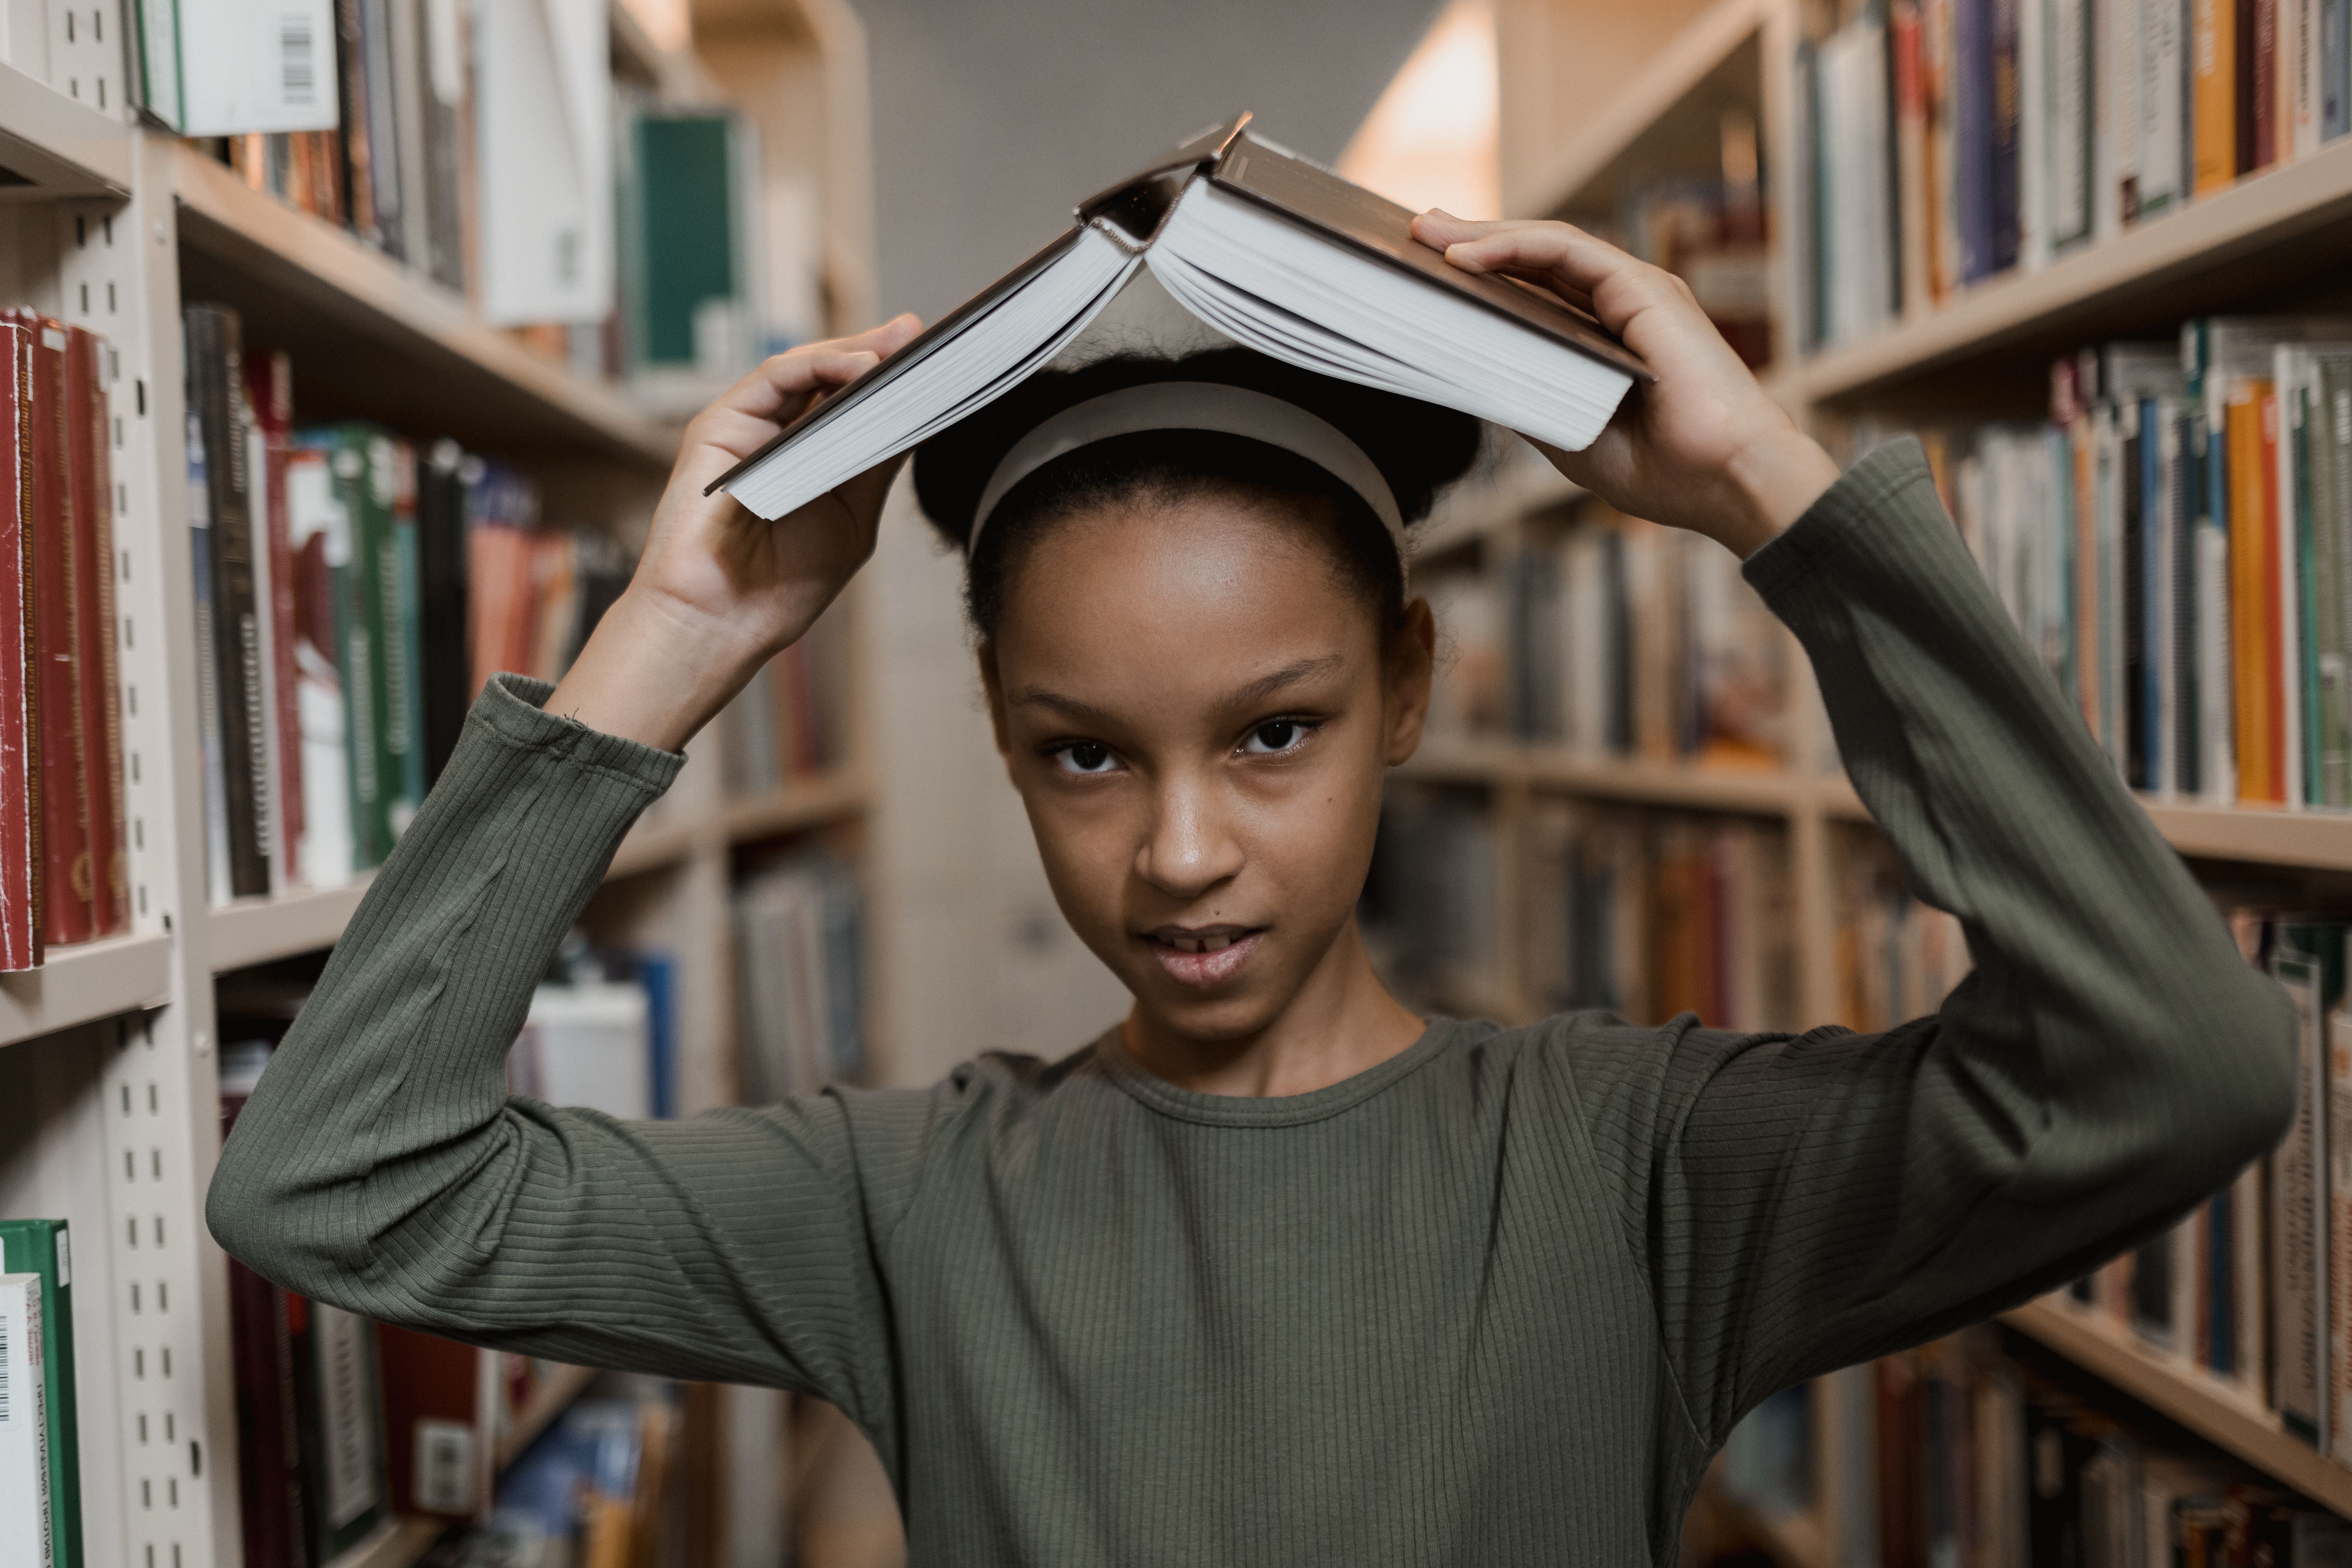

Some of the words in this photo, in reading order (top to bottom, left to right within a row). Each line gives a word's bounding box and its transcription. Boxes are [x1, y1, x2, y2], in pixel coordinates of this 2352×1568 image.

[20, 371, 30, 453] ОСОБЕННОСТИ
[23, 457, 33, 524] УГОЛОВНОЙ
[24, 529, 34, 637] ОТВЕТСТВЕННОСТИ
[28, 642, 34, 655] ЗА
[28, 660, 36, 747] ПРЕСТУПЛЕНИЯ
[37, 1384, 48, 1495] ПРЕСТУПЛЕНИЯ
